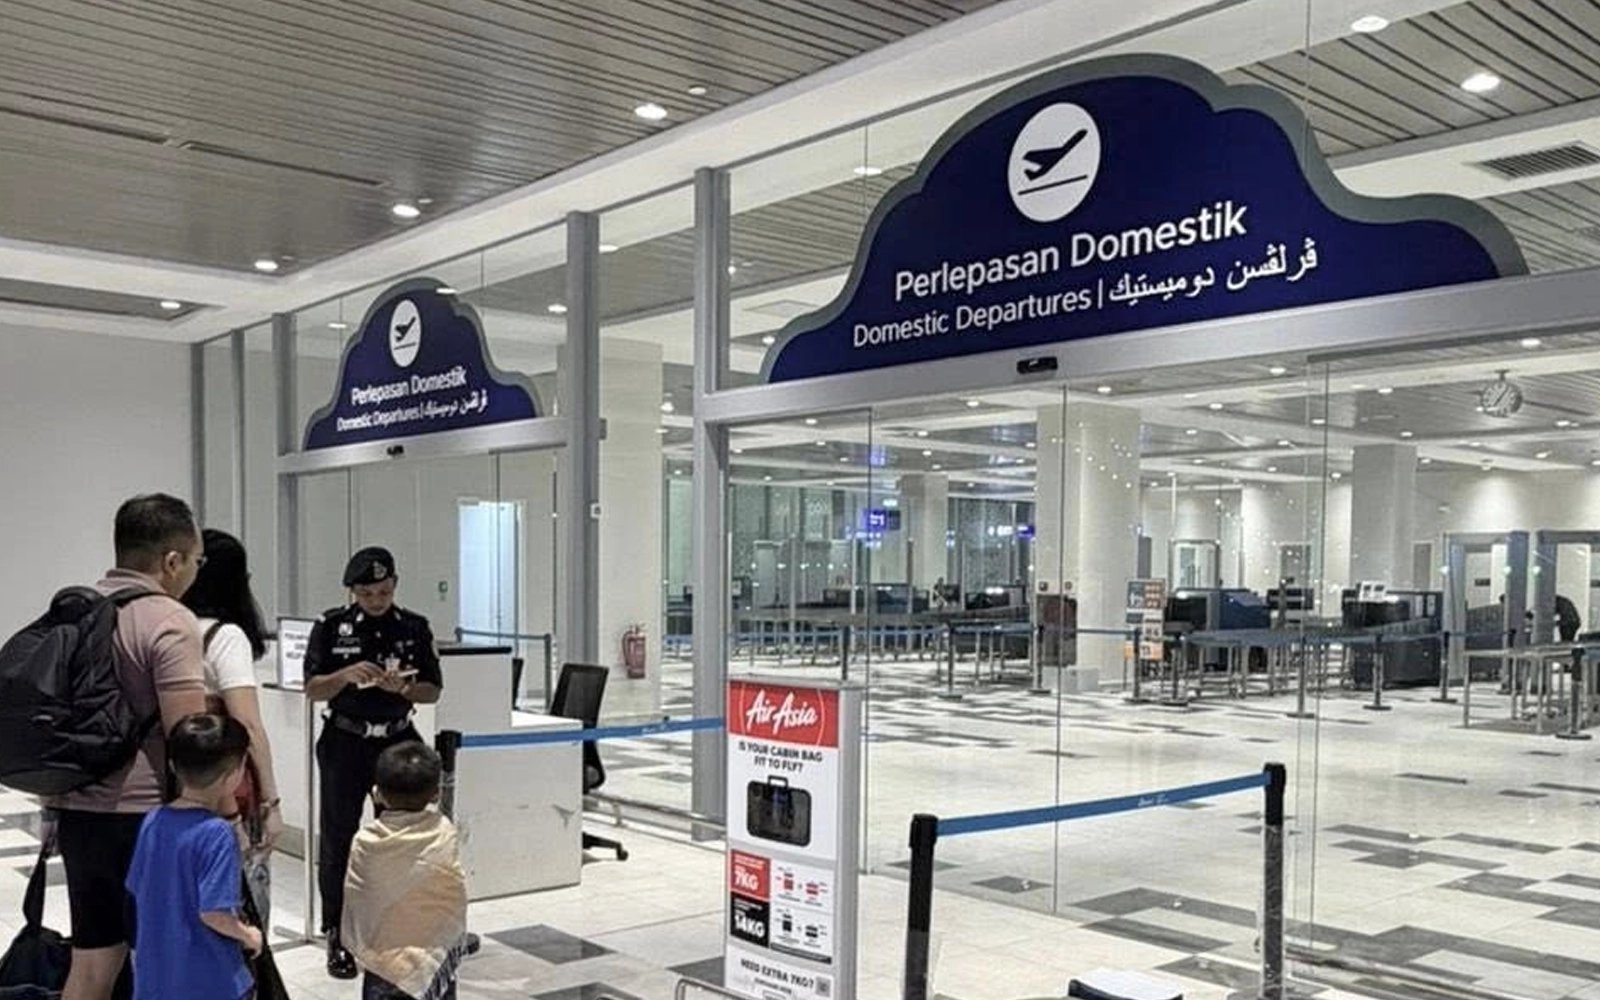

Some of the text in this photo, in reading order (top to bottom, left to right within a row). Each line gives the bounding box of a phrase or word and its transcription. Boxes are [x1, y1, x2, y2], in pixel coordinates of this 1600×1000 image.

[895, 200, 1248, 301] Perlepasan Domestik
[853, 310, 949, 348] Domestic
[956, 287, 1092, 331] Departures
[351, 365, 467, 406] Perlepasan Domestik
[337, 413, 372, 432] Domestic
[373, 405, 420, 428] Departures
[747, 742, 769, 754] YOUR
[770, 746, 800, 759] CABIN
[801, 750, 823, 762] BAG
[754, 755, 804, 772] FIT TO FLY?
[761, 965, 789, 983] EXTRA
